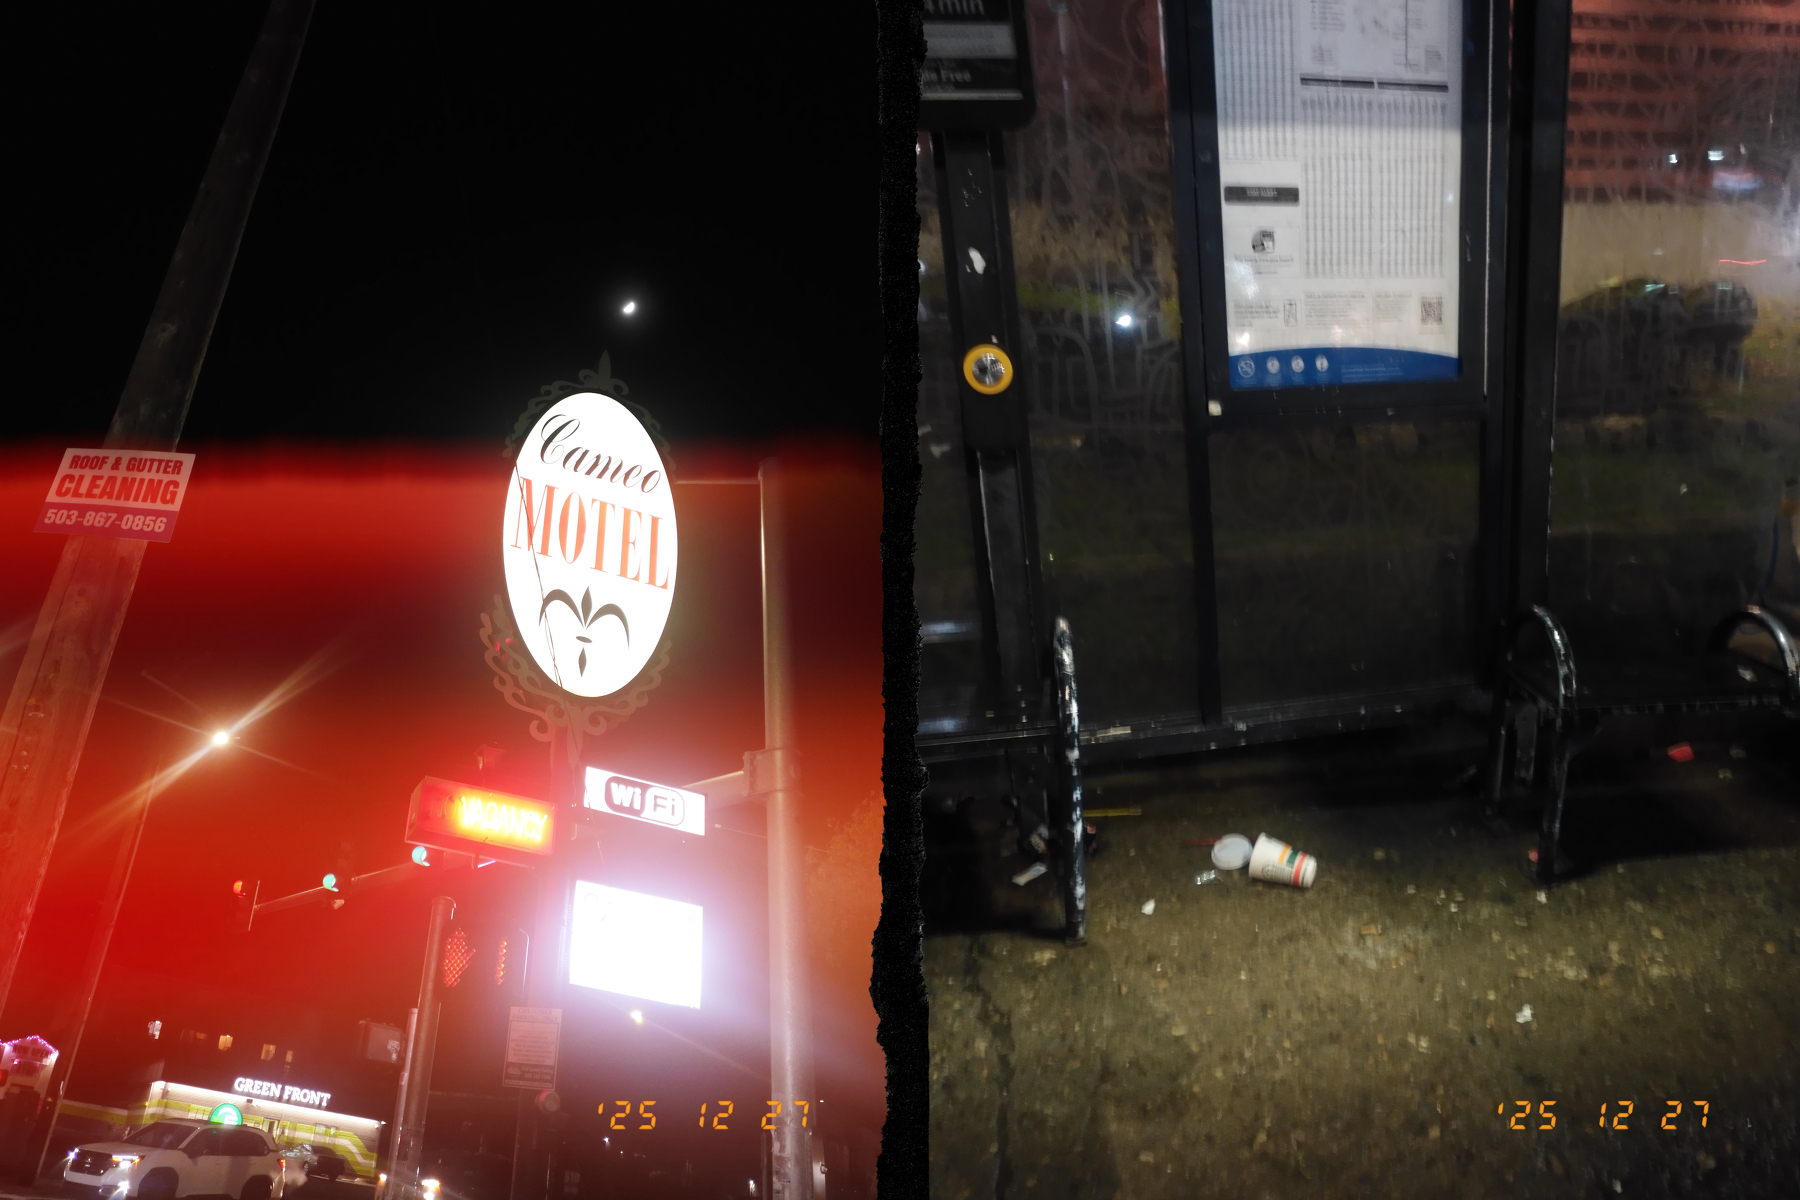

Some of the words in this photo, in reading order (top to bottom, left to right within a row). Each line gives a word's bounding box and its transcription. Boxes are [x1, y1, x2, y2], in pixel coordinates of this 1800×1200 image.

[68, 454, 110, 471] ROOF
[110, 455, 123, 471] &
[125, 457, 184, 476] GUTTER
[540, 413, 662, 494] Cameo
[55, 474, 180, 505] CLEANING
[44, 508, 167, 533] 503-867-0856
[510, 476, 670, 590] MOTEL
[460, 795, 548, 842] VACANCY
[512, 1013, 540, 1021] PARKING
[517, 1007, 553, 1015] CUSTOMER
[234, 1077, 282, 1098] GREEN
[283, 1085, 332, 1107] FRONT
